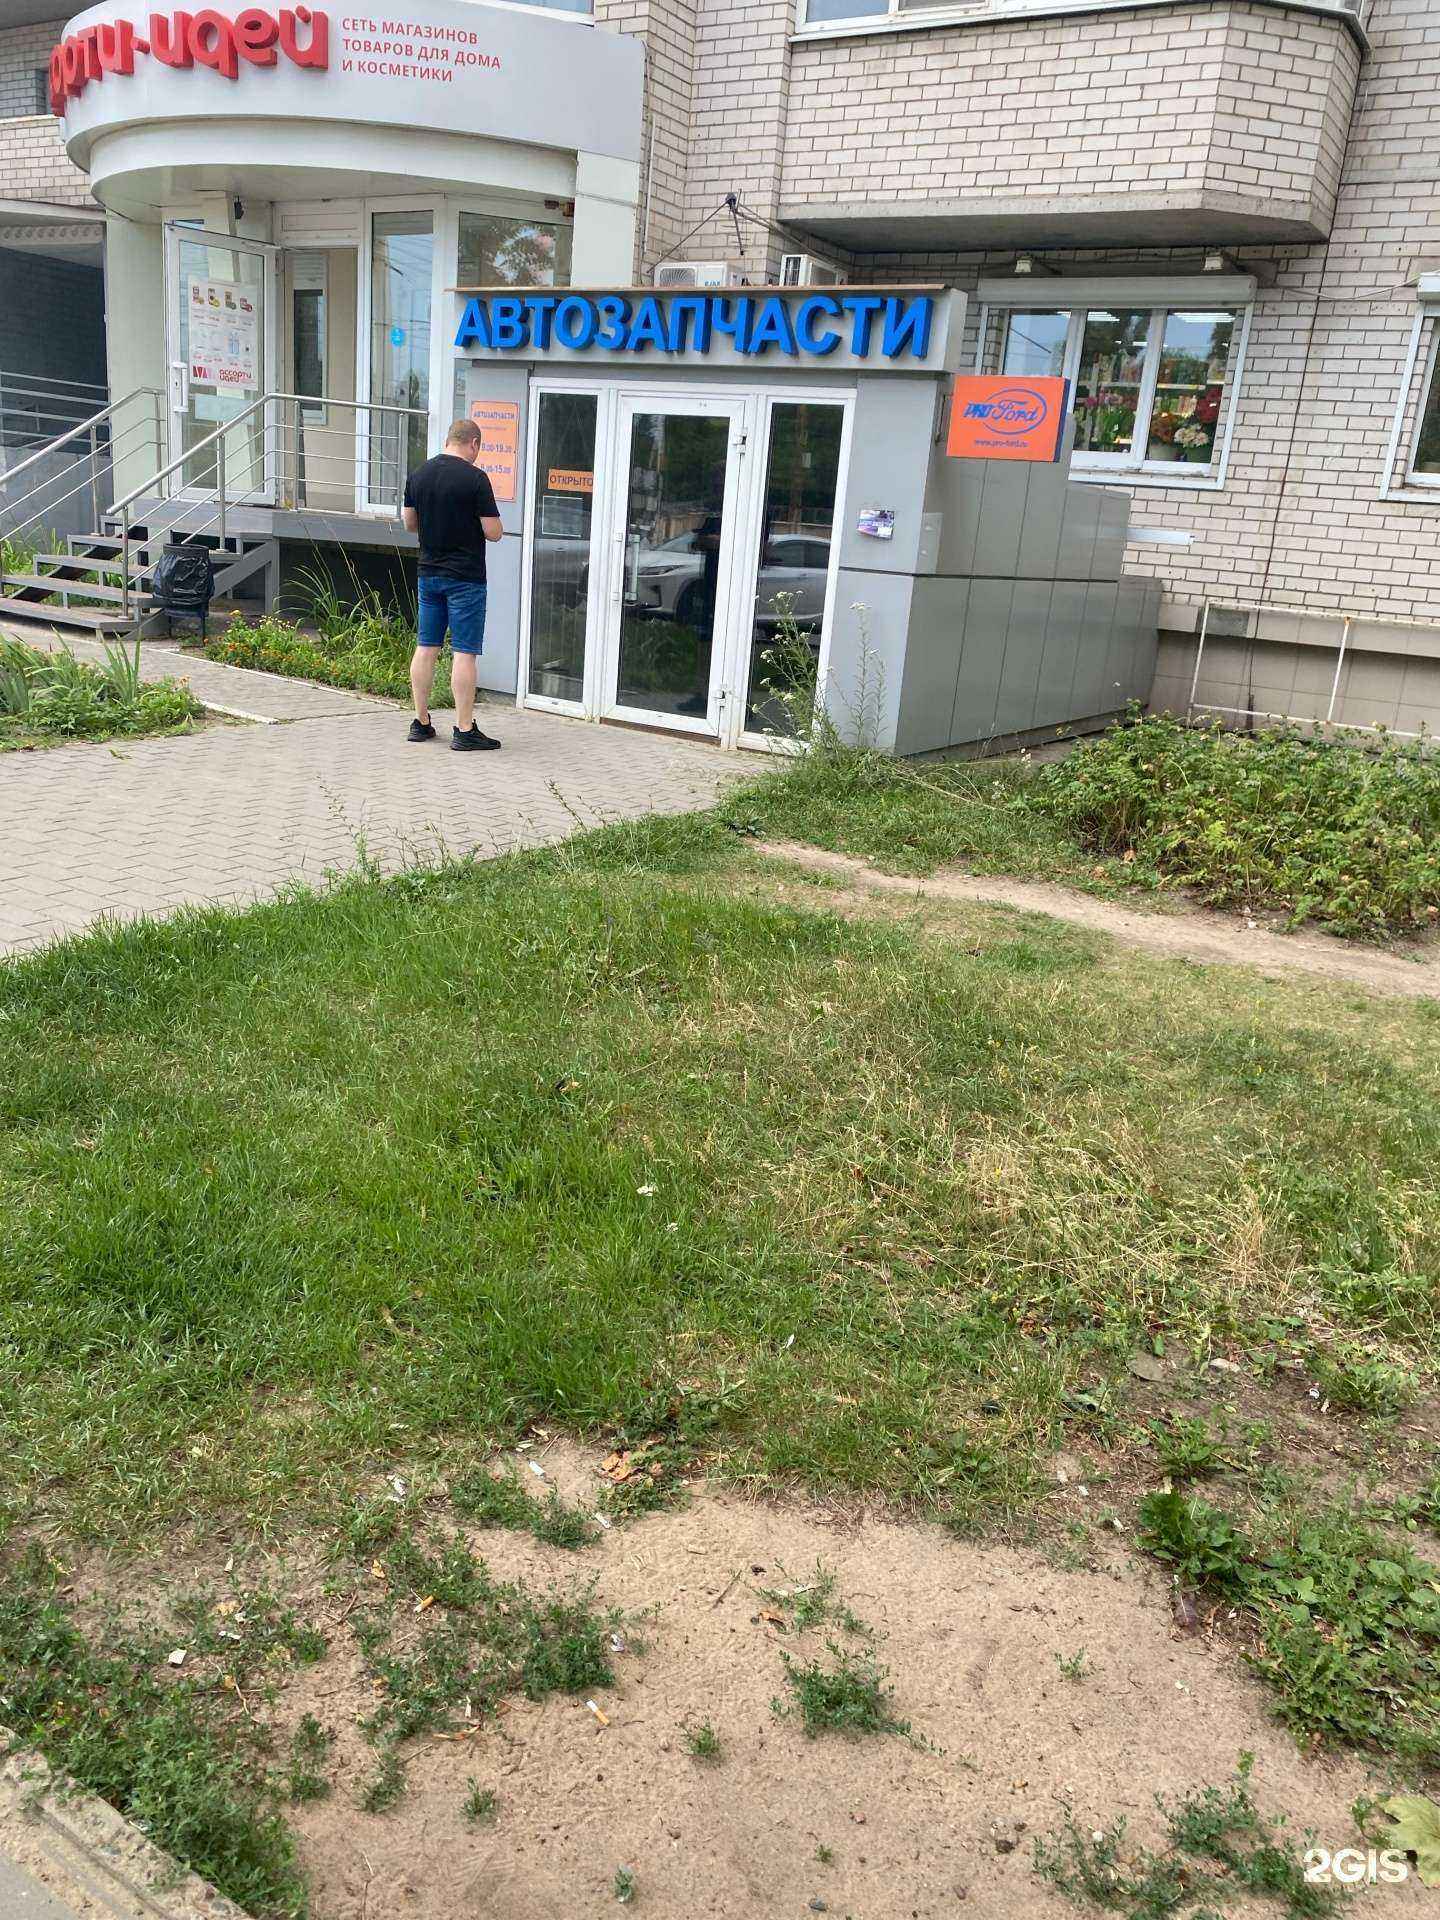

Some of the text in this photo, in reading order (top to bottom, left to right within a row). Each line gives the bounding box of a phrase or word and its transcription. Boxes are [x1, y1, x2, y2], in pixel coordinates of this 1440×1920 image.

[342, 18, 478, 45] СЕТЬ МАГАЗИНОВ
[342, 38, 502, 70] ТОВАРОВ ДЛЯ ДОМА
[342, 60, 453, 82] И КОСМЕТИКИ
[454, 297, 933, 358] АВТОЗАПЧАСТИ
[992, 399, 1040, 422] Ford
[550, 474, 593, 486] ОТКРЫТО
